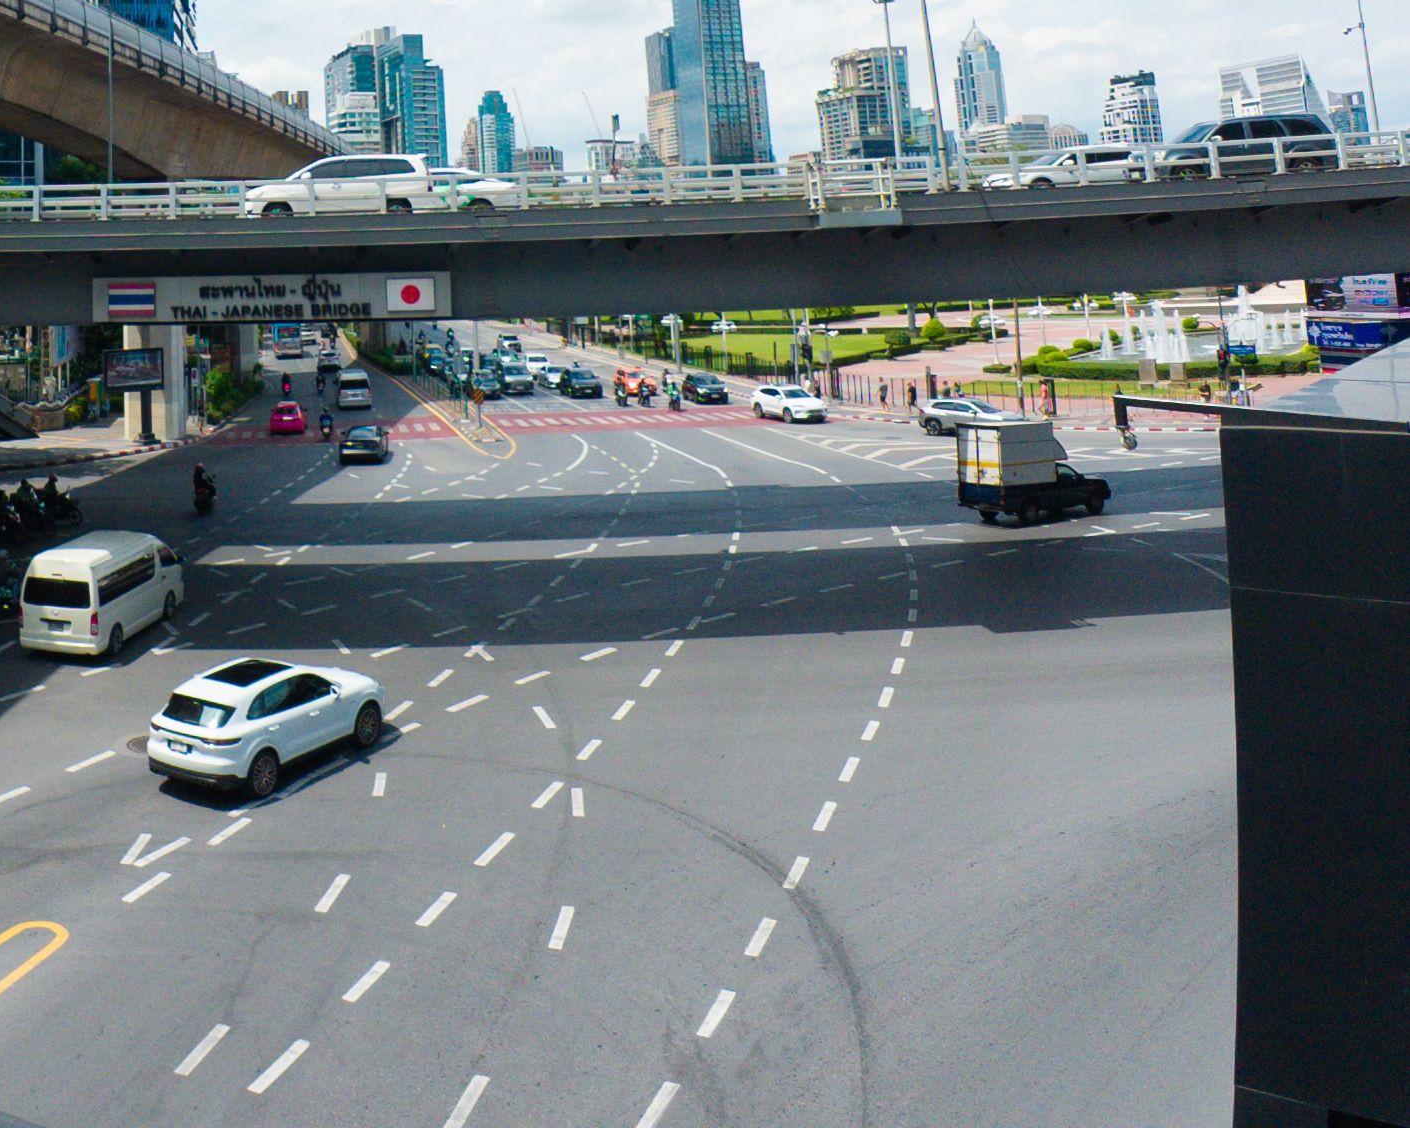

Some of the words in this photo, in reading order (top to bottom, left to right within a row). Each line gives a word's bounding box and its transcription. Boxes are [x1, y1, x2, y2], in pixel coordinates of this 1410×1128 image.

[199, 276, 286, 300] สะพานไทย
[301, 274, 342, 302] ญี่ปุ่น
[171, 306, 207, 320] THAI
[221, 303, 304, 319] JAPANESE
[310, 302, 372, 318] BRIDGE
